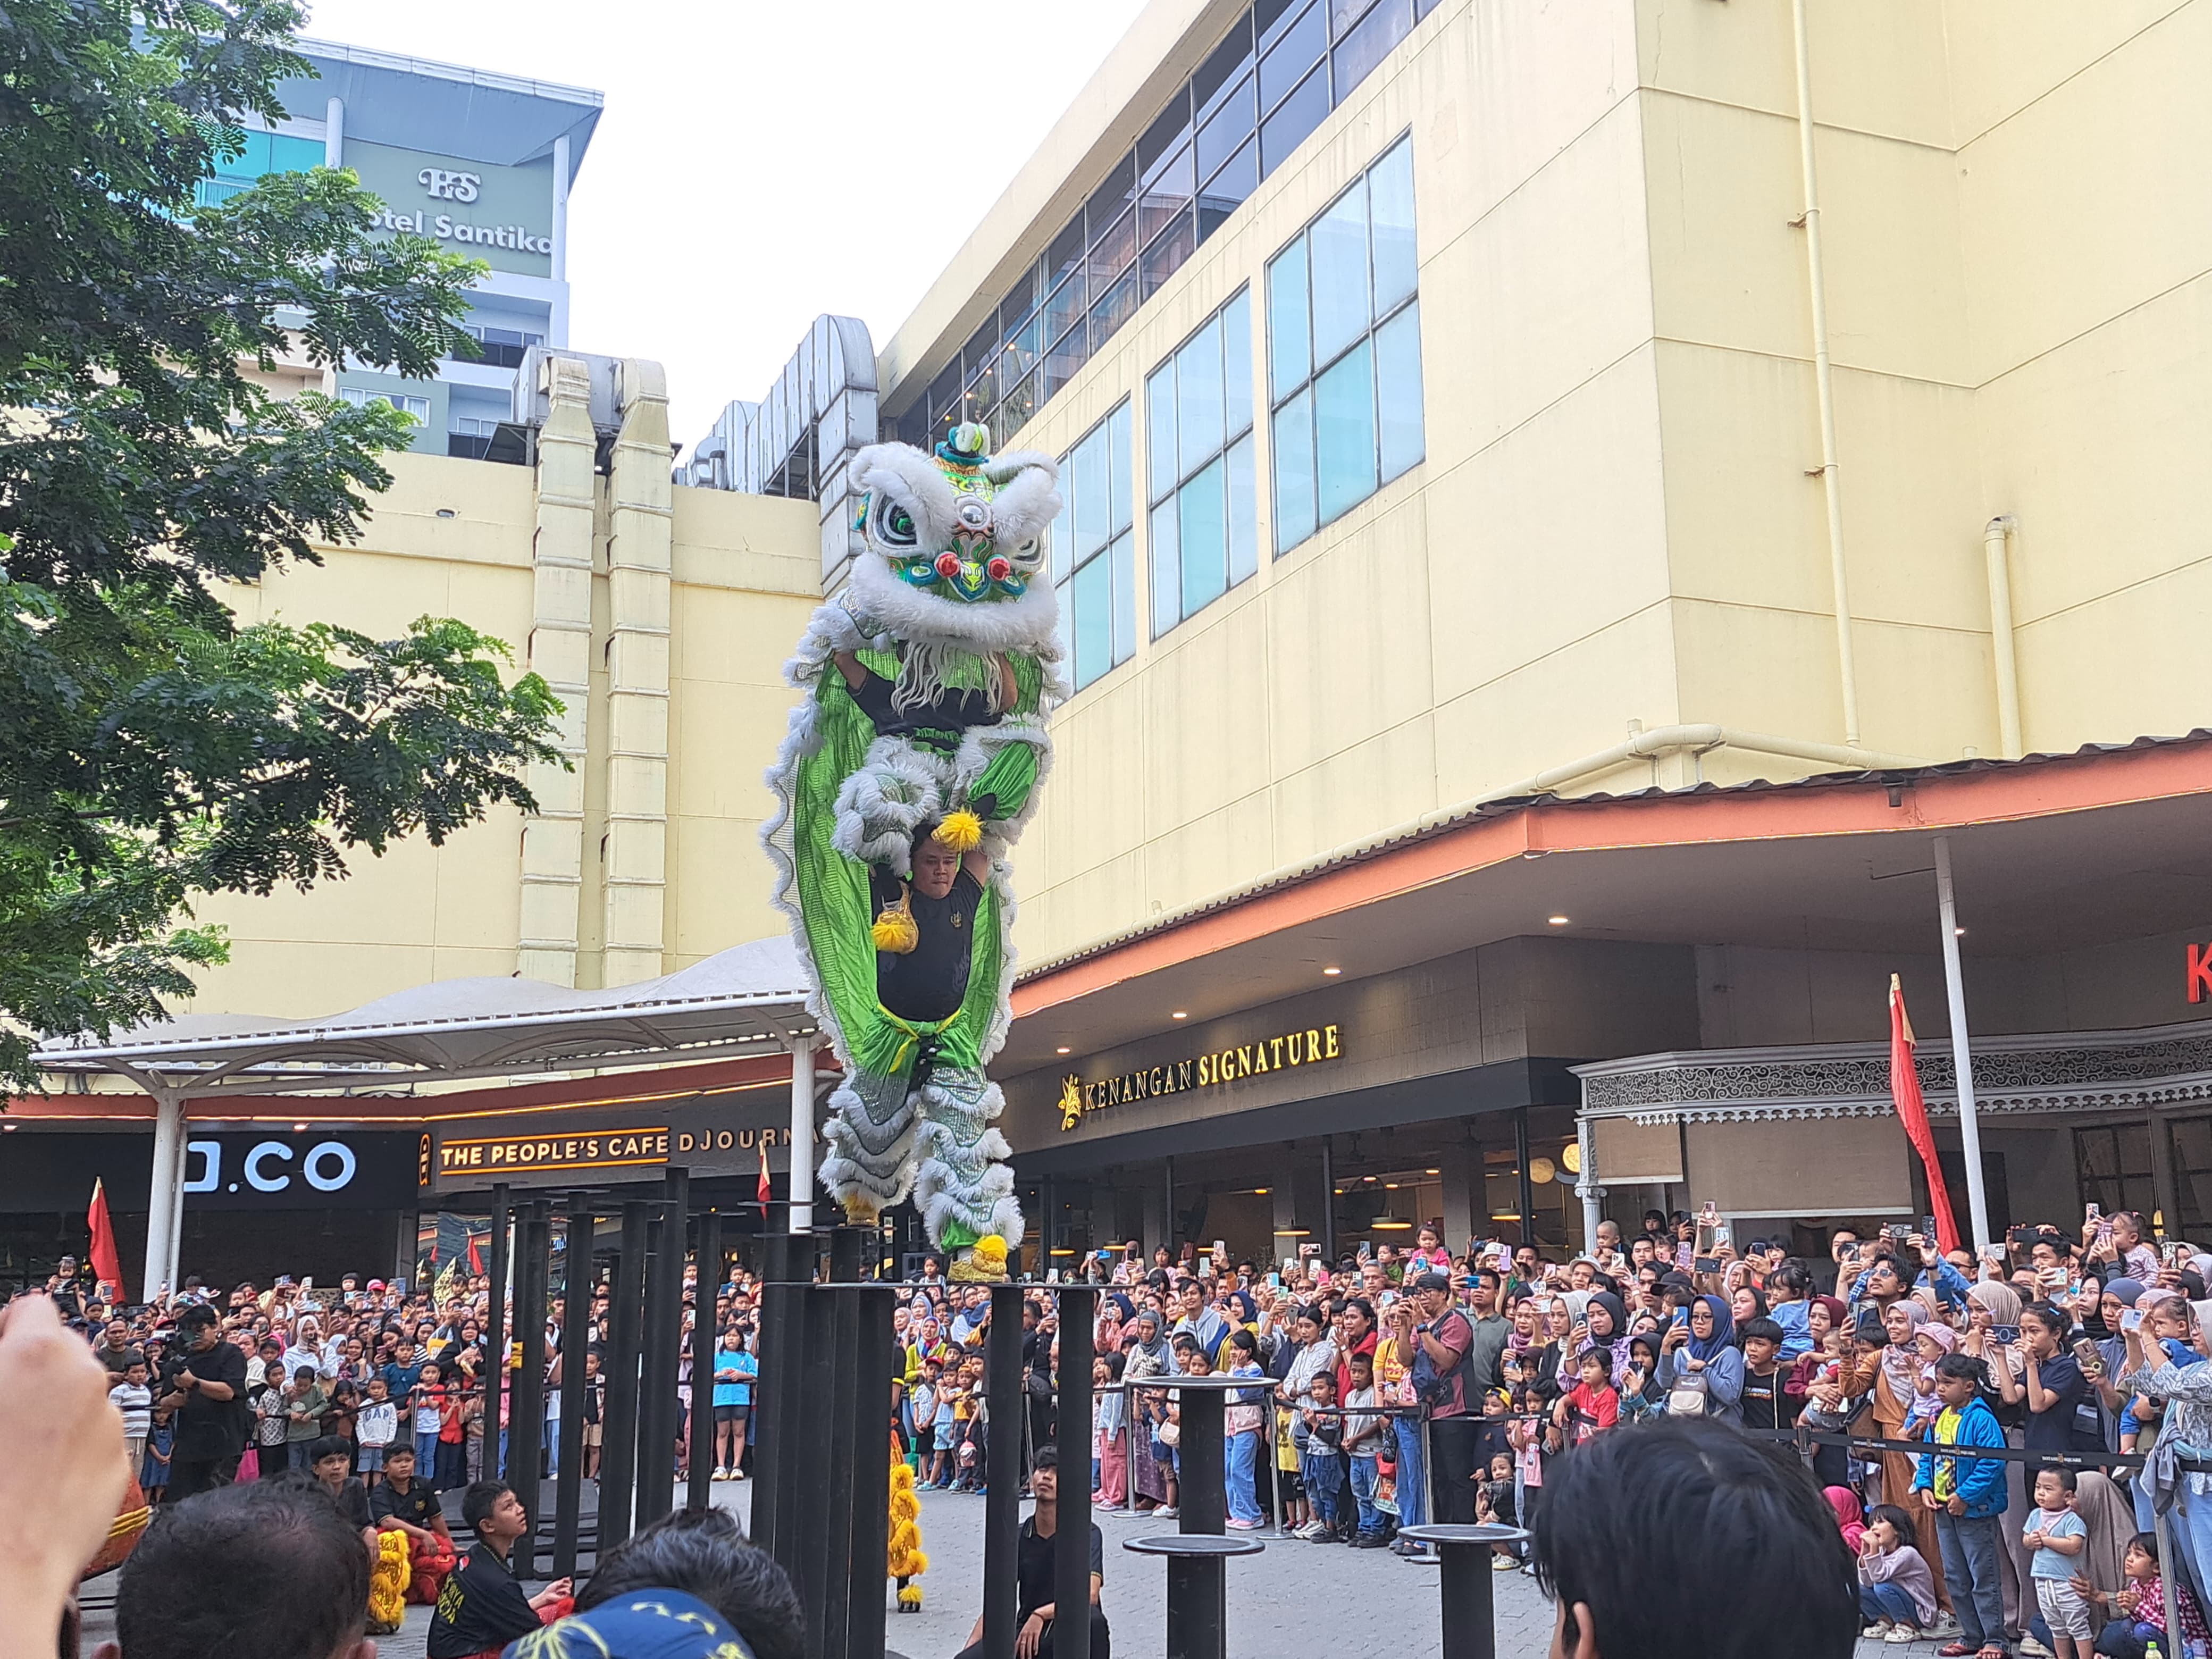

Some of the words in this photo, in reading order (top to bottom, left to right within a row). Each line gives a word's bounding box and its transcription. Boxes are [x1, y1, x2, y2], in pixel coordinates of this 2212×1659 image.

[417, 167, 481, 203] HS
[367, 207, 423, 233] otel
[434, 214, 554, 254] Santika
[1085, 1059, 1192, 1111] KENANGAN
[1199, 1025, 1339, 1086] SIGNATURE
[184, 1141, 356, 1192] J.CO
[440, 1146, 482, 1167] THE
[490, 1139, 600, 1164] PEOPLE'S
[608, 1135, 669, 1158] CAFE
